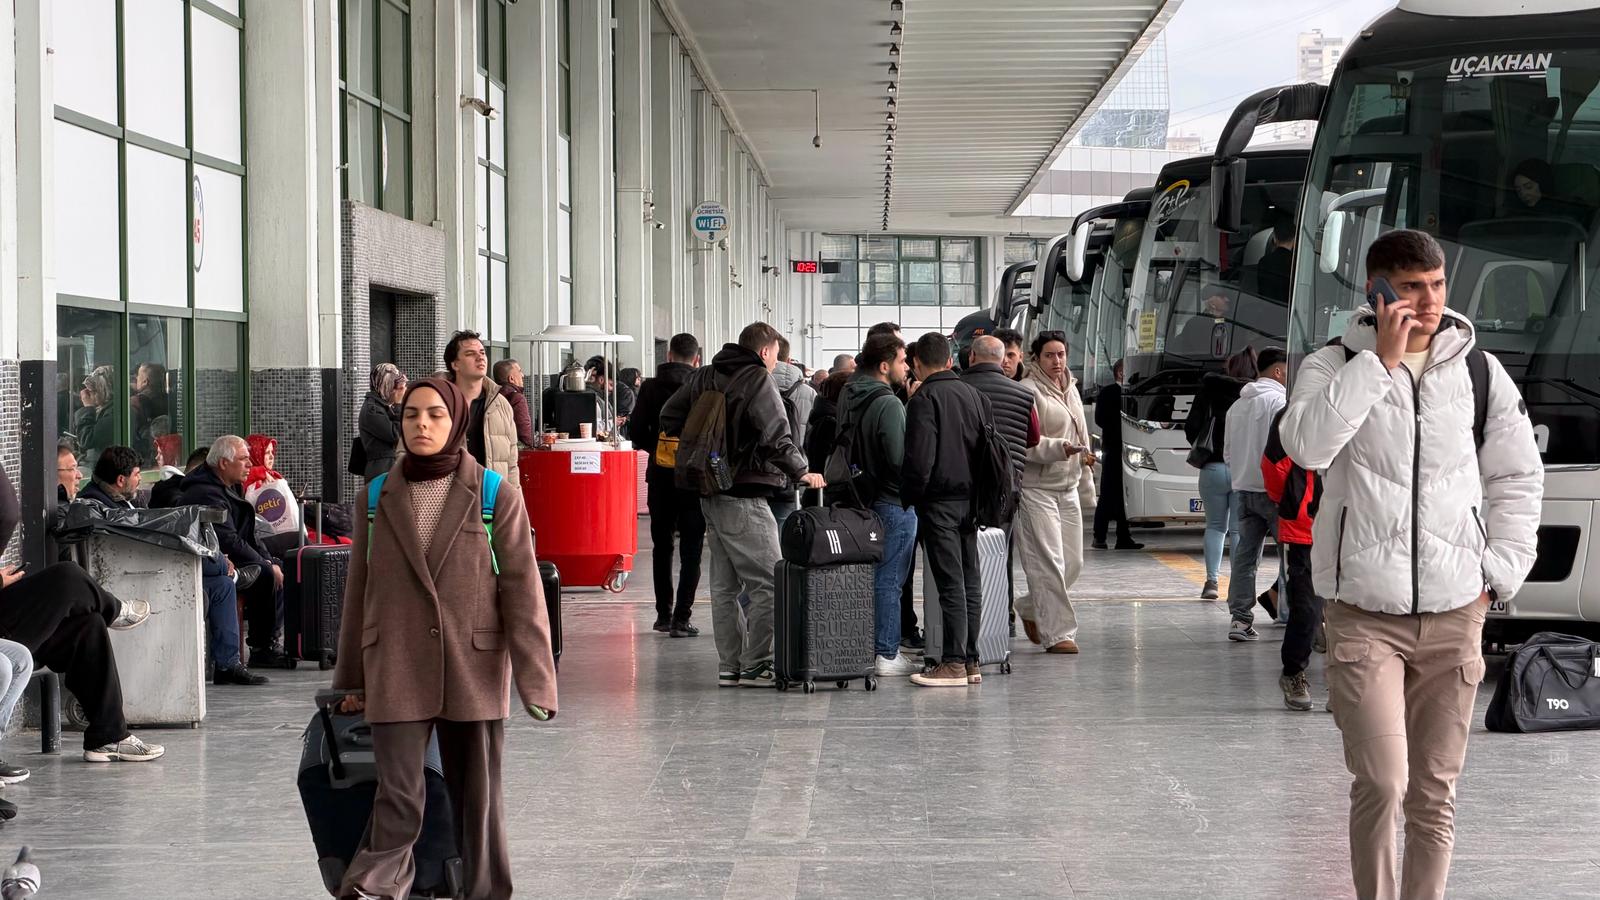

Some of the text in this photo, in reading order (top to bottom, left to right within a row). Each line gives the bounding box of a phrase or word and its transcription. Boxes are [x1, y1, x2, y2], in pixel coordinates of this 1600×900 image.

[1449, 52, 1553, 78] UÇAKHAN
[797, 262, 816, 273] 10:25
[257, 497, 281, 514] getir
[1194, 500, 1202, 511] 27
[824, 574, 867, 591] PARIS
[824, 591, 866, 600] NEW YORK
[810, 611, 869, 621] LOS ANGELES
[816, 620, 866, 637] DUBAI
[816, 638, 867, 649] MOSCOW
[809, 651, 833, 666] RIO
[834, 649, 867, 657] ANTALYA
[823, 665, 860, 674] BAHAMAS
[1546, 698, 1569, 710] T90
